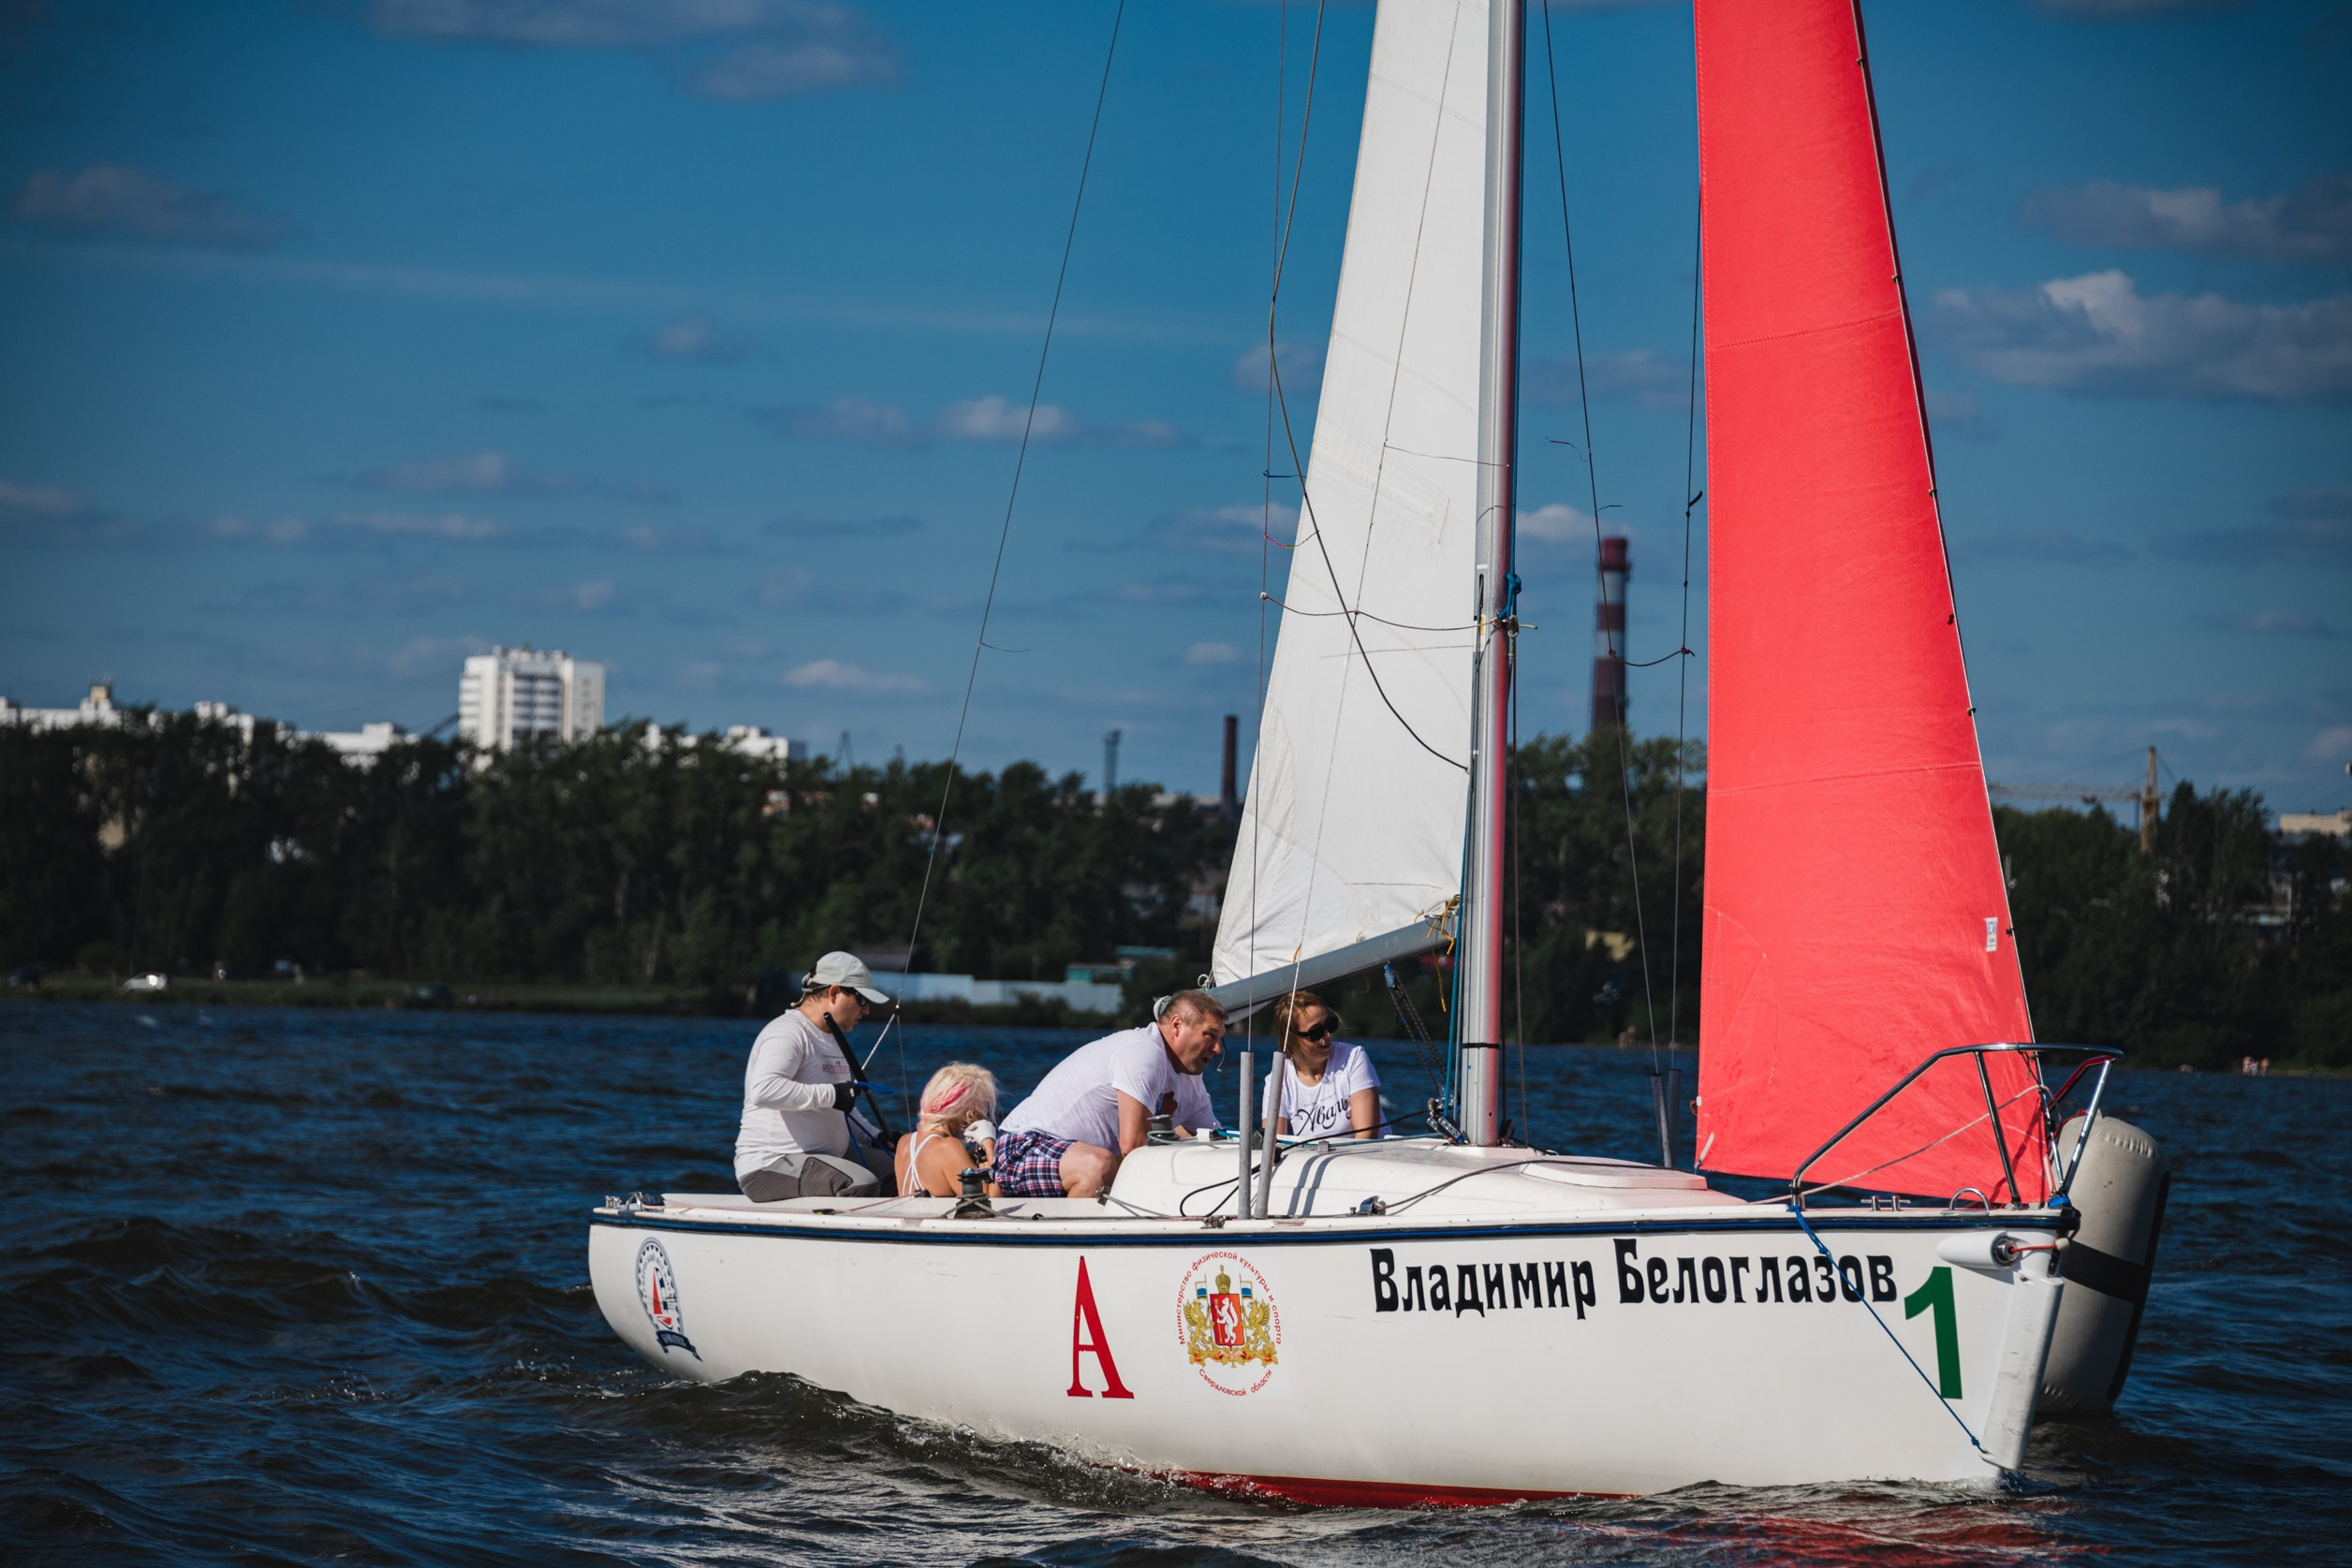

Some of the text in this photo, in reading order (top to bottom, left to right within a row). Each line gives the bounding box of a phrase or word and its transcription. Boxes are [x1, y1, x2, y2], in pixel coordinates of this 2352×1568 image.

[1176, 1270, 1193, 1345] Министерство
[1192, 1251, 1238, 1271] физической
[1239, 1257, 1270, 1292] культуры
[1272, 1305, 1282, 1345] спорта
[1370, 1238, 1898, 1320] Владимир Белоглазов
[1904, 1266, 1963, 1400] 1
[1198, 1368, 1272, 1397] Свердловской области
